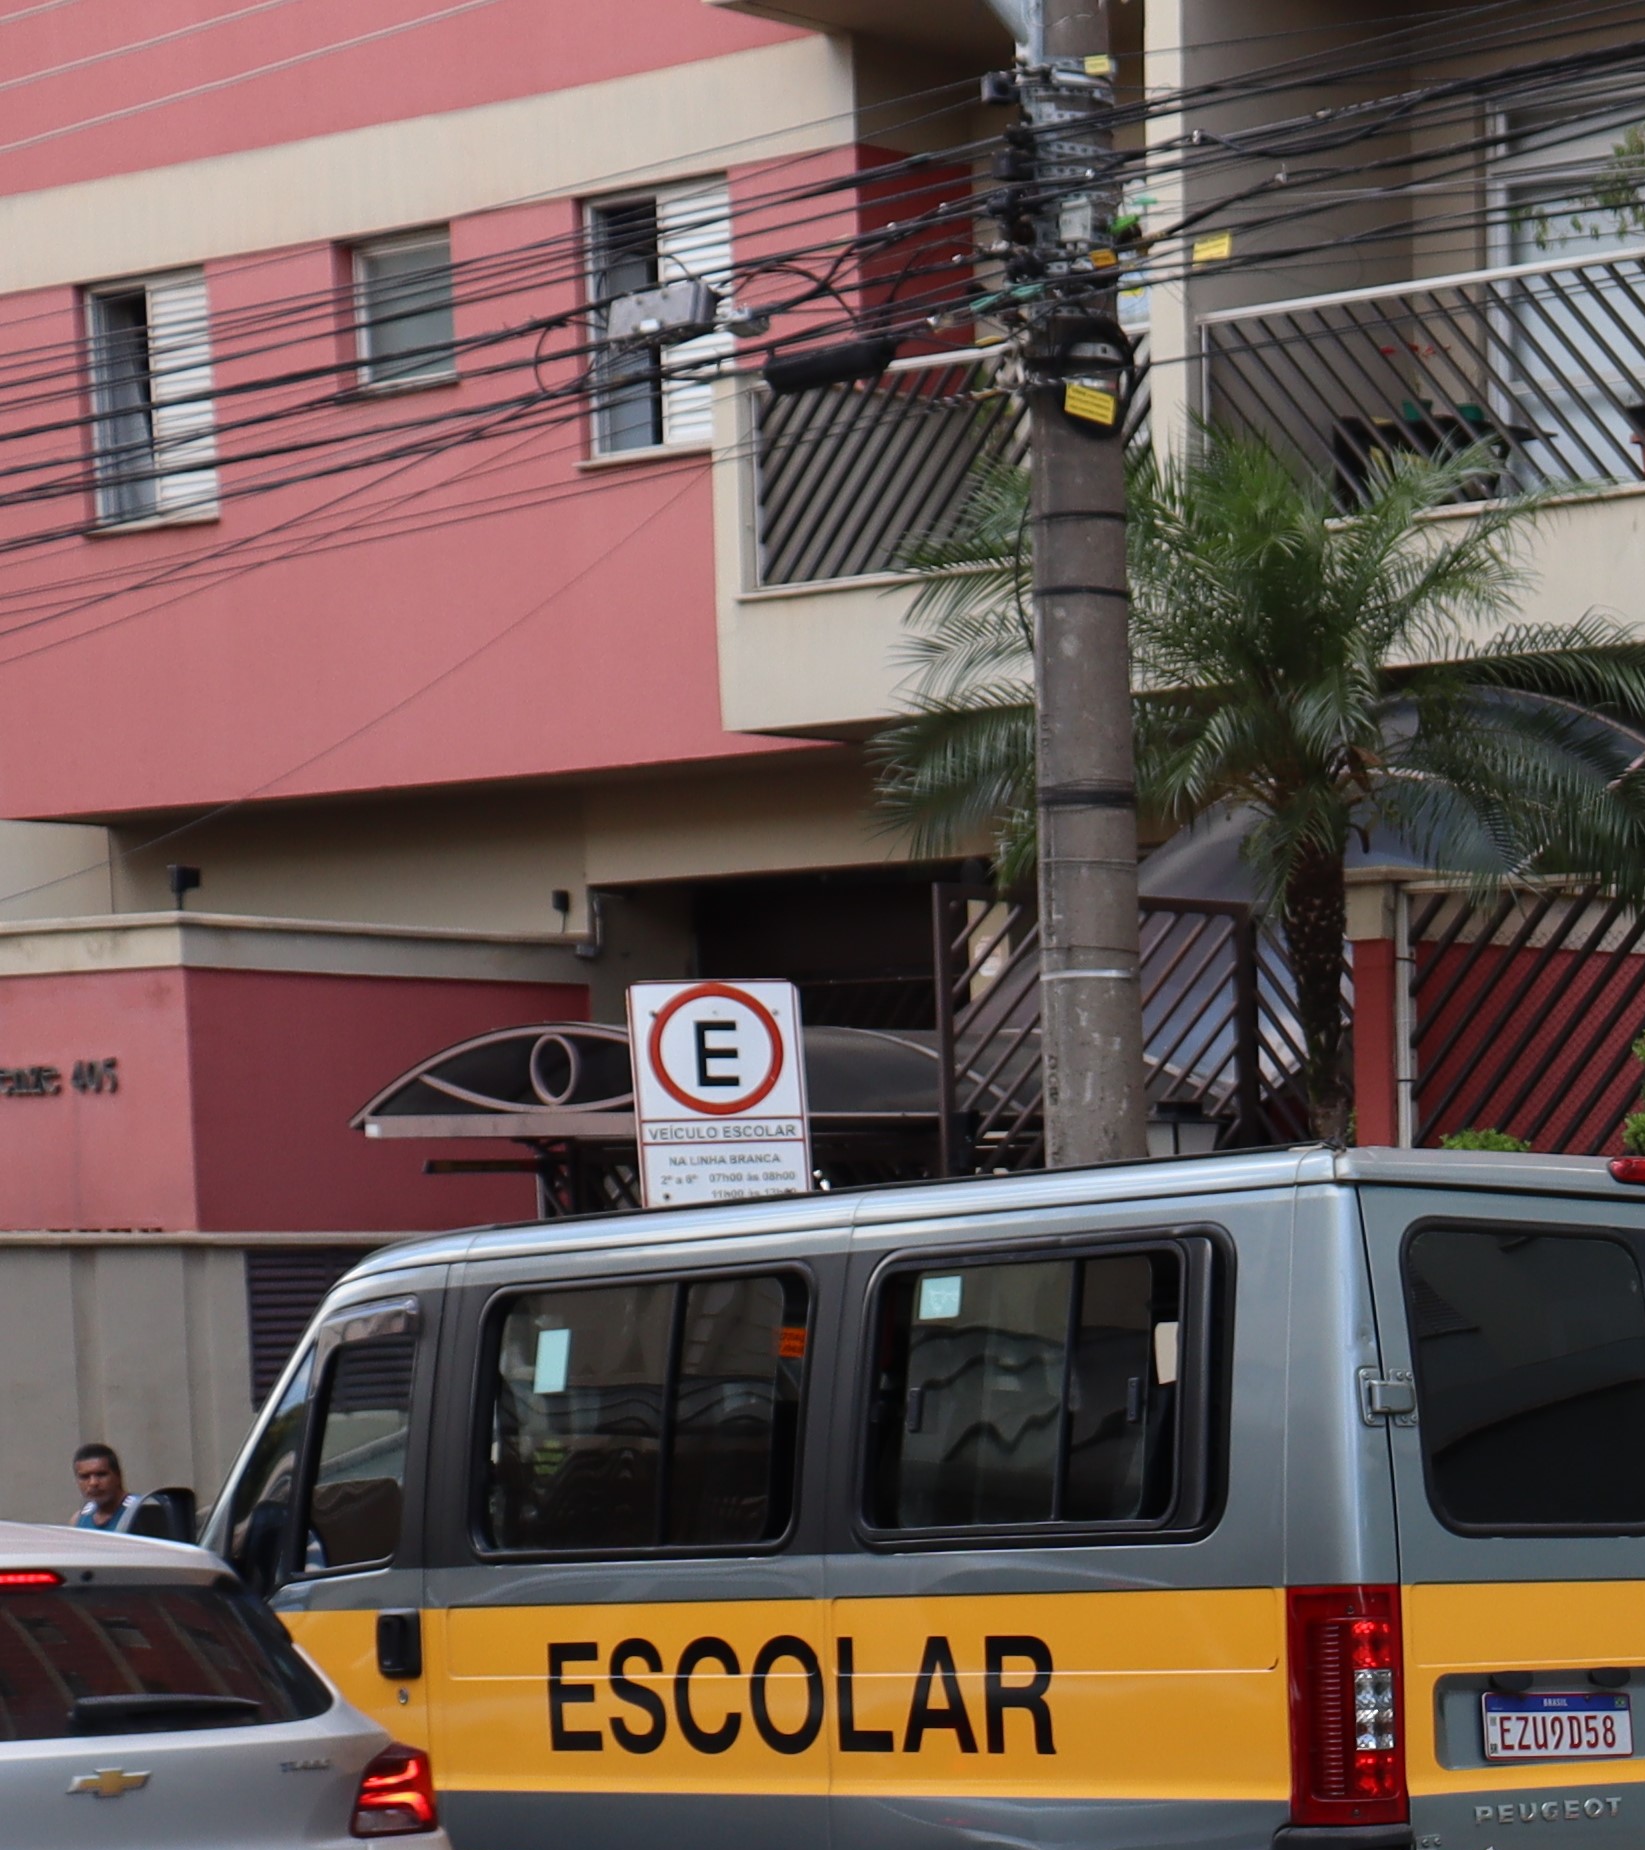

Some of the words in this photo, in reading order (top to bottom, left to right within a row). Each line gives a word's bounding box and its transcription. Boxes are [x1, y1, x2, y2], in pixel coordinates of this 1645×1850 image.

[694, 1020, 740, 1087] E
[649, 1125, 718, 1140] VEÍCULO
[723, 1124, 797, 1138] ESCOLAR
[669, 1156, 687, 1167] NA
[690, 1155, 726, 1166] LINHA
[730, 1153, 781, 1164] BRANCA
[547, 1634, 1058, 1755] ESCOLAR
[1543, 1697, 1568, 1707] BRASIL
[1499, 1714, 1616, 1751] EZU9D58
[1474, 1796, 1623, 1826] PEUGEOT
